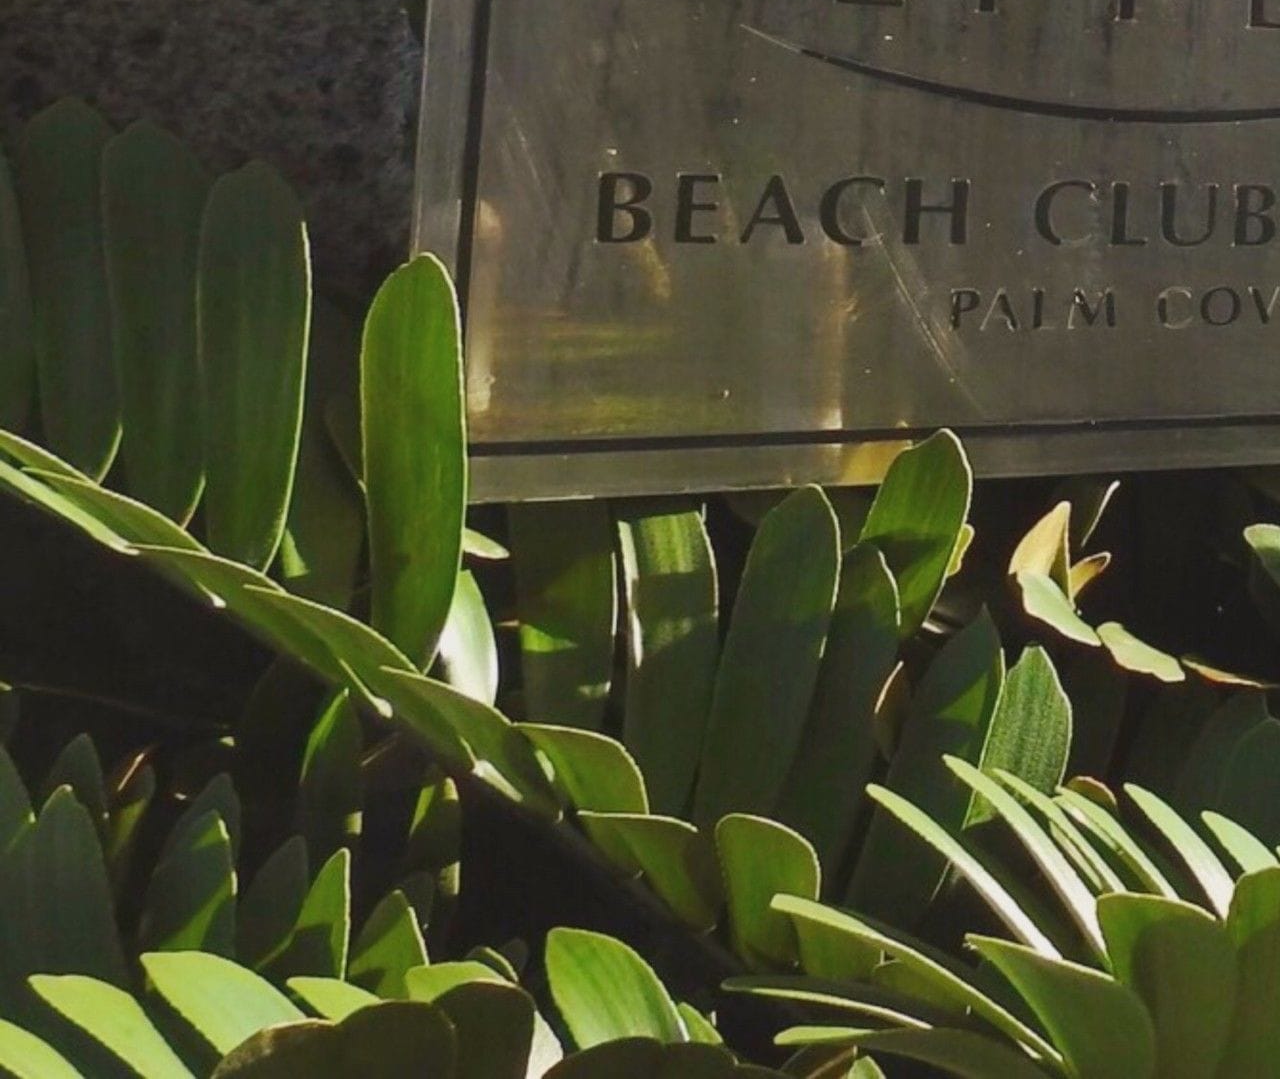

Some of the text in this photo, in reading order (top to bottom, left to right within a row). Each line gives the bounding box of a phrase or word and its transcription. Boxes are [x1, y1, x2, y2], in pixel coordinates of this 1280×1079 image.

[596, 171, 971, 246] BEACH
[1034, 178, 1277, 248] CLUB
[950, 286, 1118, 332] PALM
